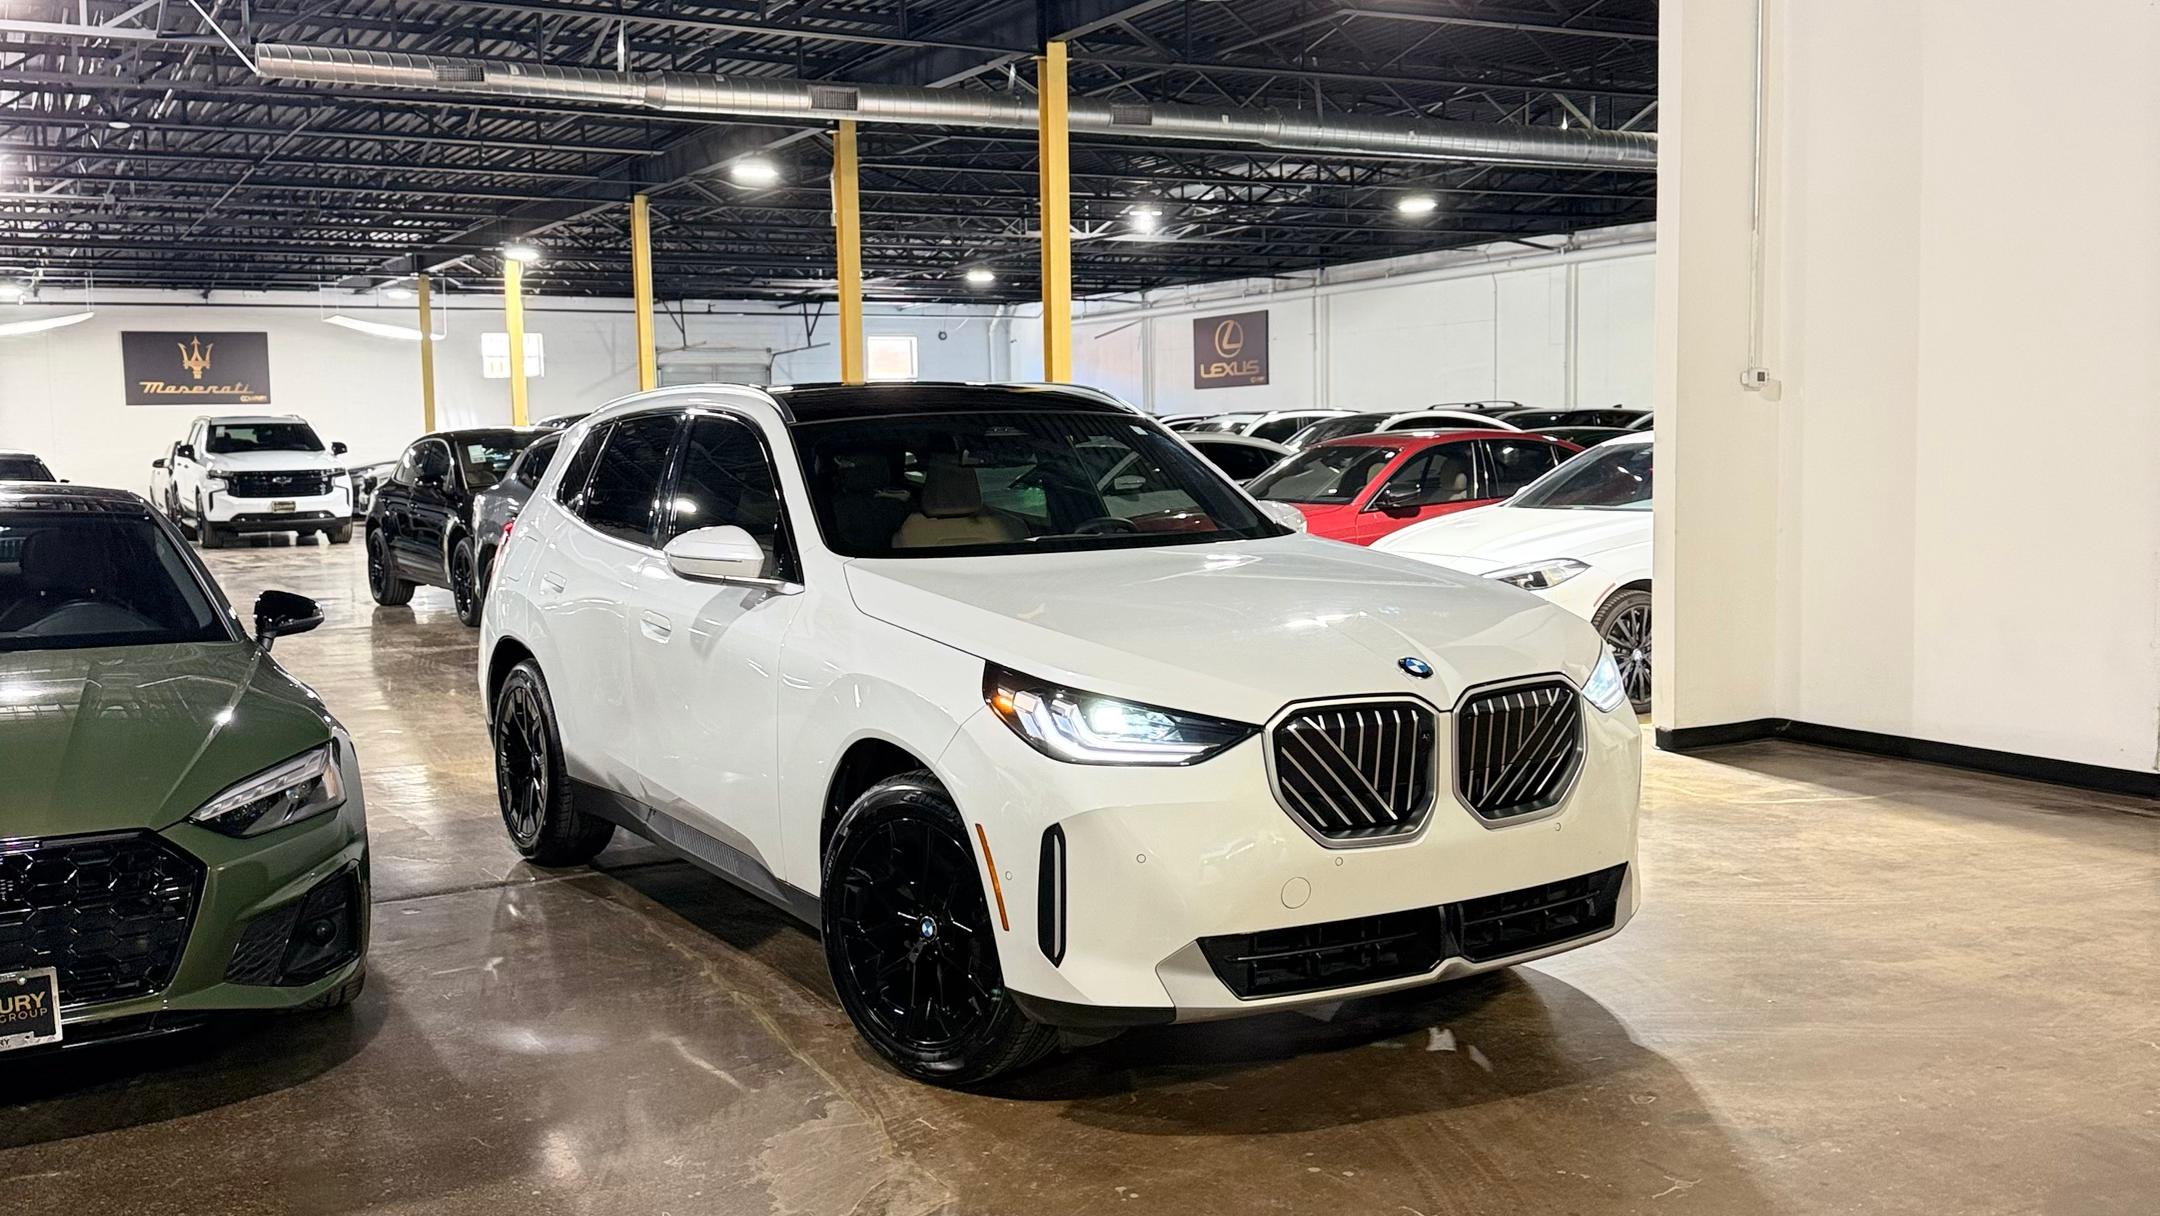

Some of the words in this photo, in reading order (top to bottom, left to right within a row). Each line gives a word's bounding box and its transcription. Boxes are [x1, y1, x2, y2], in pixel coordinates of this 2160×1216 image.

[1200, 360, 1260, 378] LEXUS
[139, 379, 255, 394] Maserati
[0, 1007, 48, 1024] GROUP
